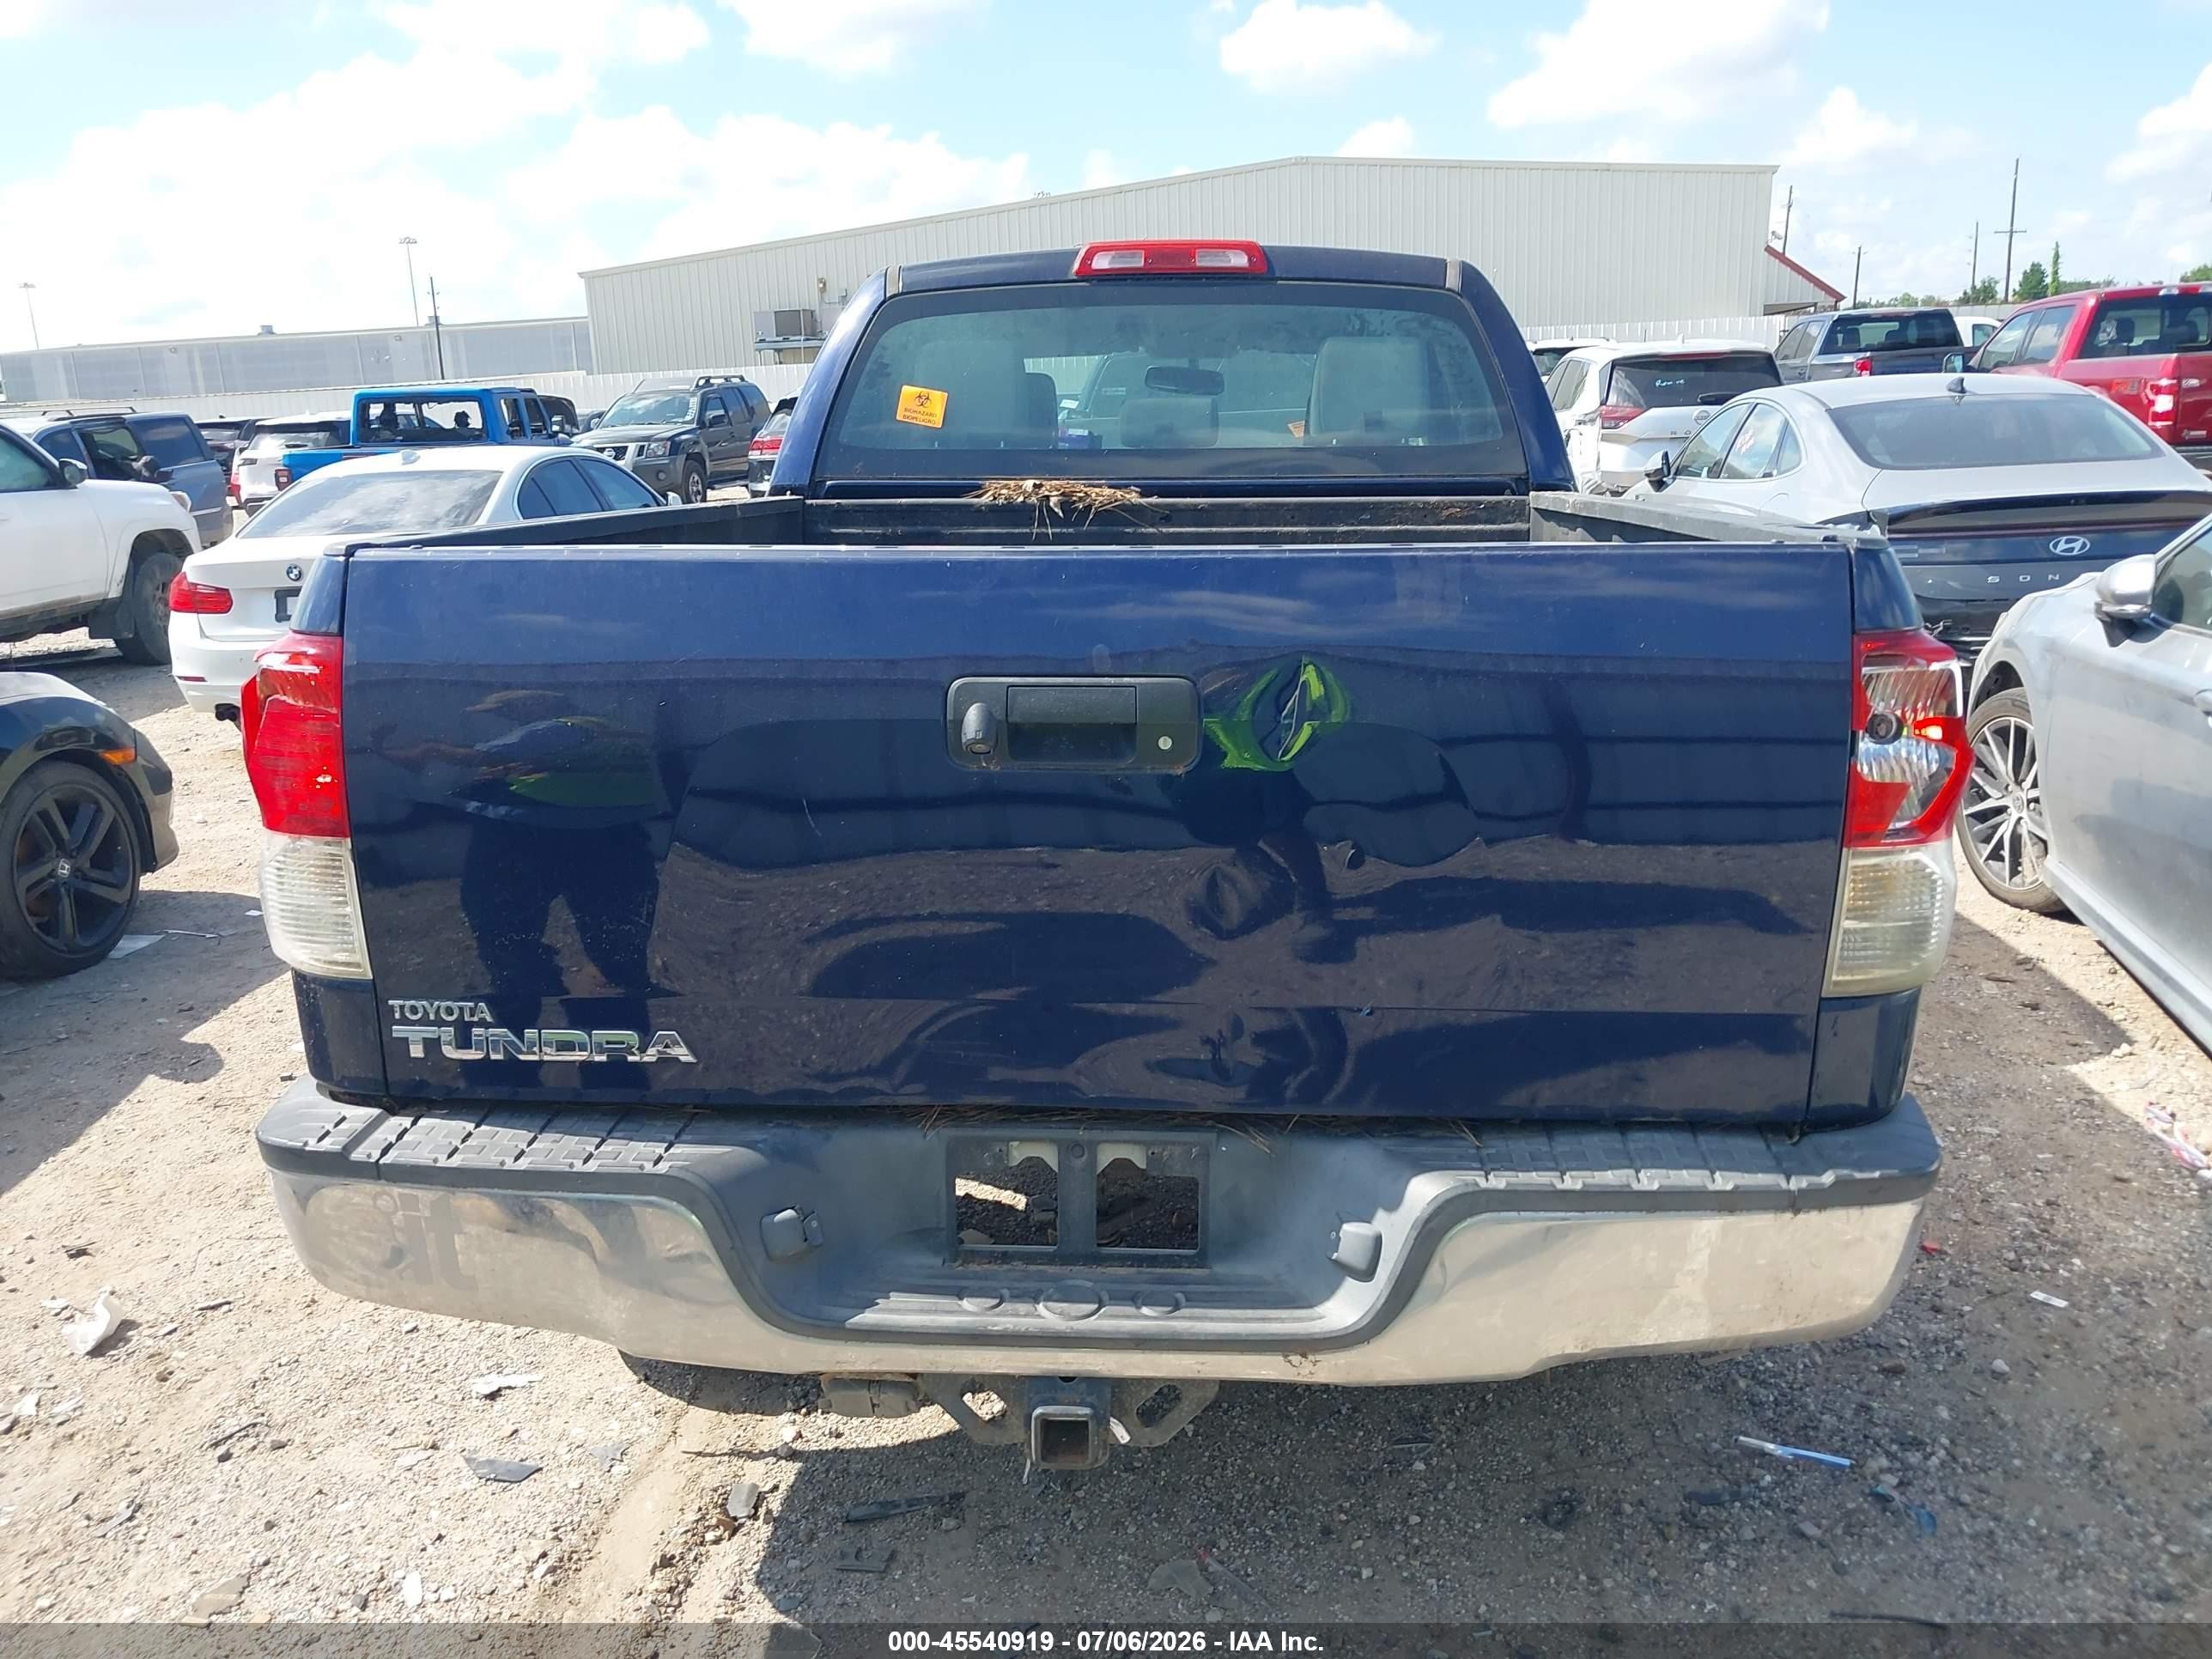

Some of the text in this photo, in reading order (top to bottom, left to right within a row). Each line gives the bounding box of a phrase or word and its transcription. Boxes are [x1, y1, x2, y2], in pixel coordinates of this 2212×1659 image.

[902, 414, 936, 425] BIOPELIGRO
[904, 407, 938, 418] BIOHAZARD
[388, 1000, 495, 1023] TOYOTA
[392, 1025, 699, 1064] TUNDRA
